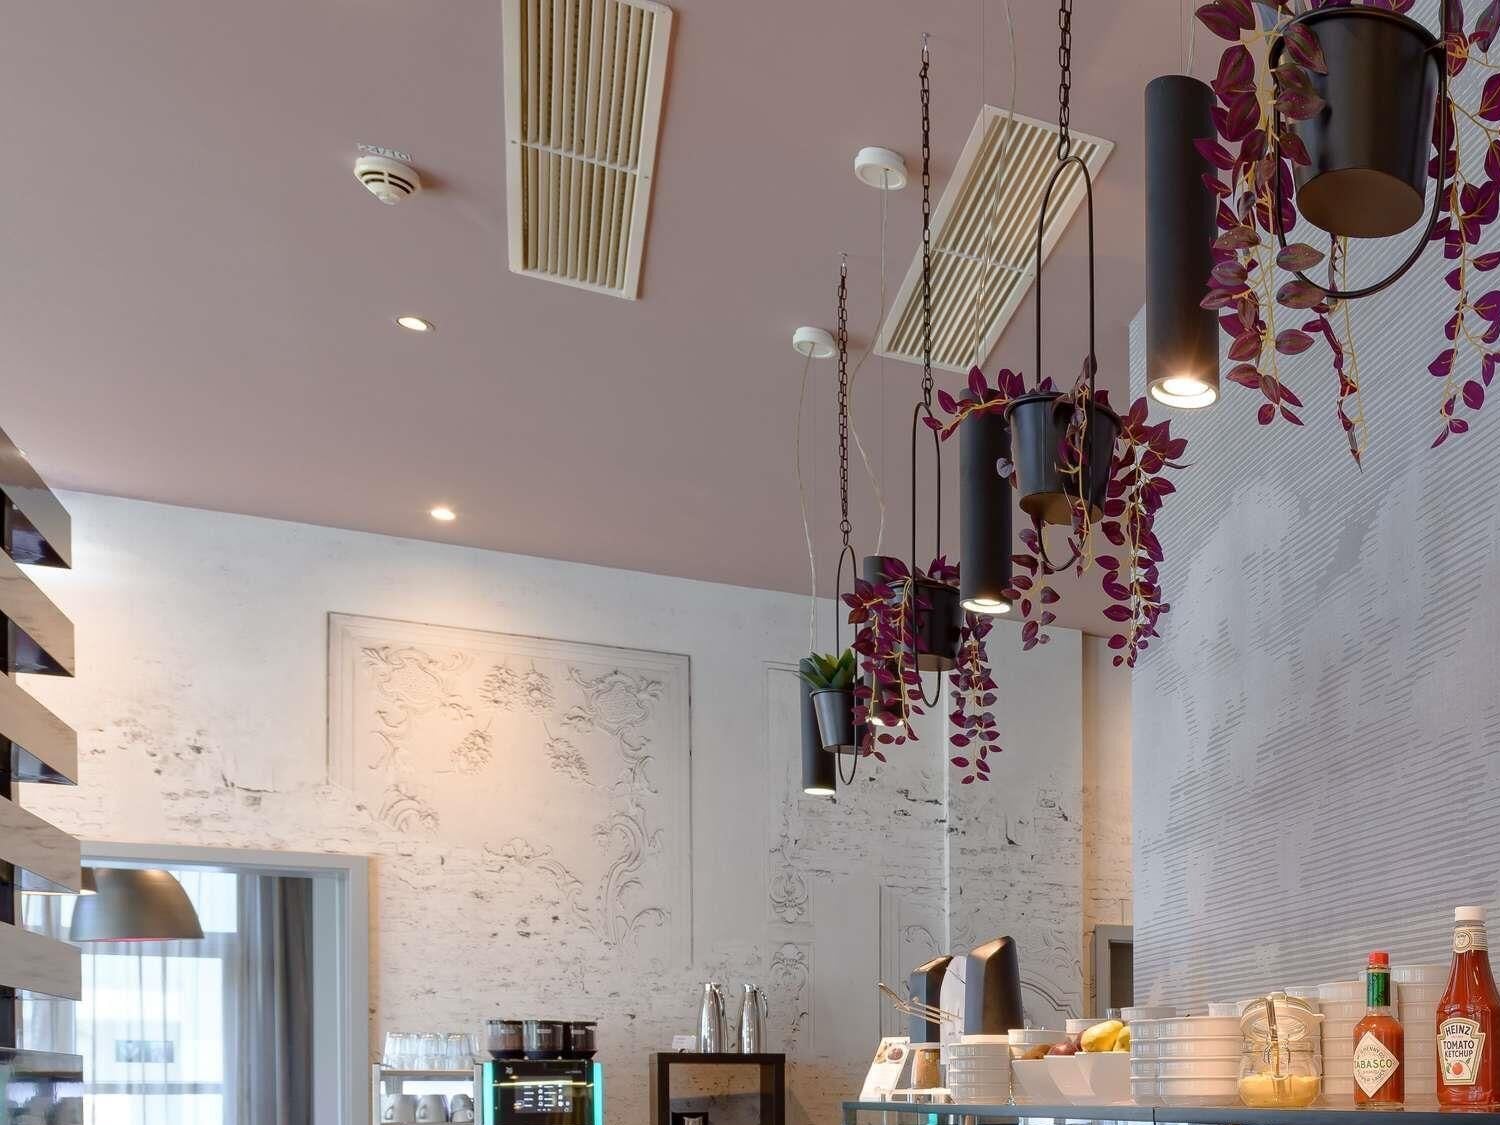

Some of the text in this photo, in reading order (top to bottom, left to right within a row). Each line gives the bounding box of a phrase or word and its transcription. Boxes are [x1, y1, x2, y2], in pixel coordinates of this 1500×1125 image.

[1445, 1024, 1471, 1036] HEINZ
[1443, 1040, 1475, 1050] TOMATO
[1444, 1049, 1474, 1058] KETCHUP
[1355, 1058, 1393, 1069] ABASCO
